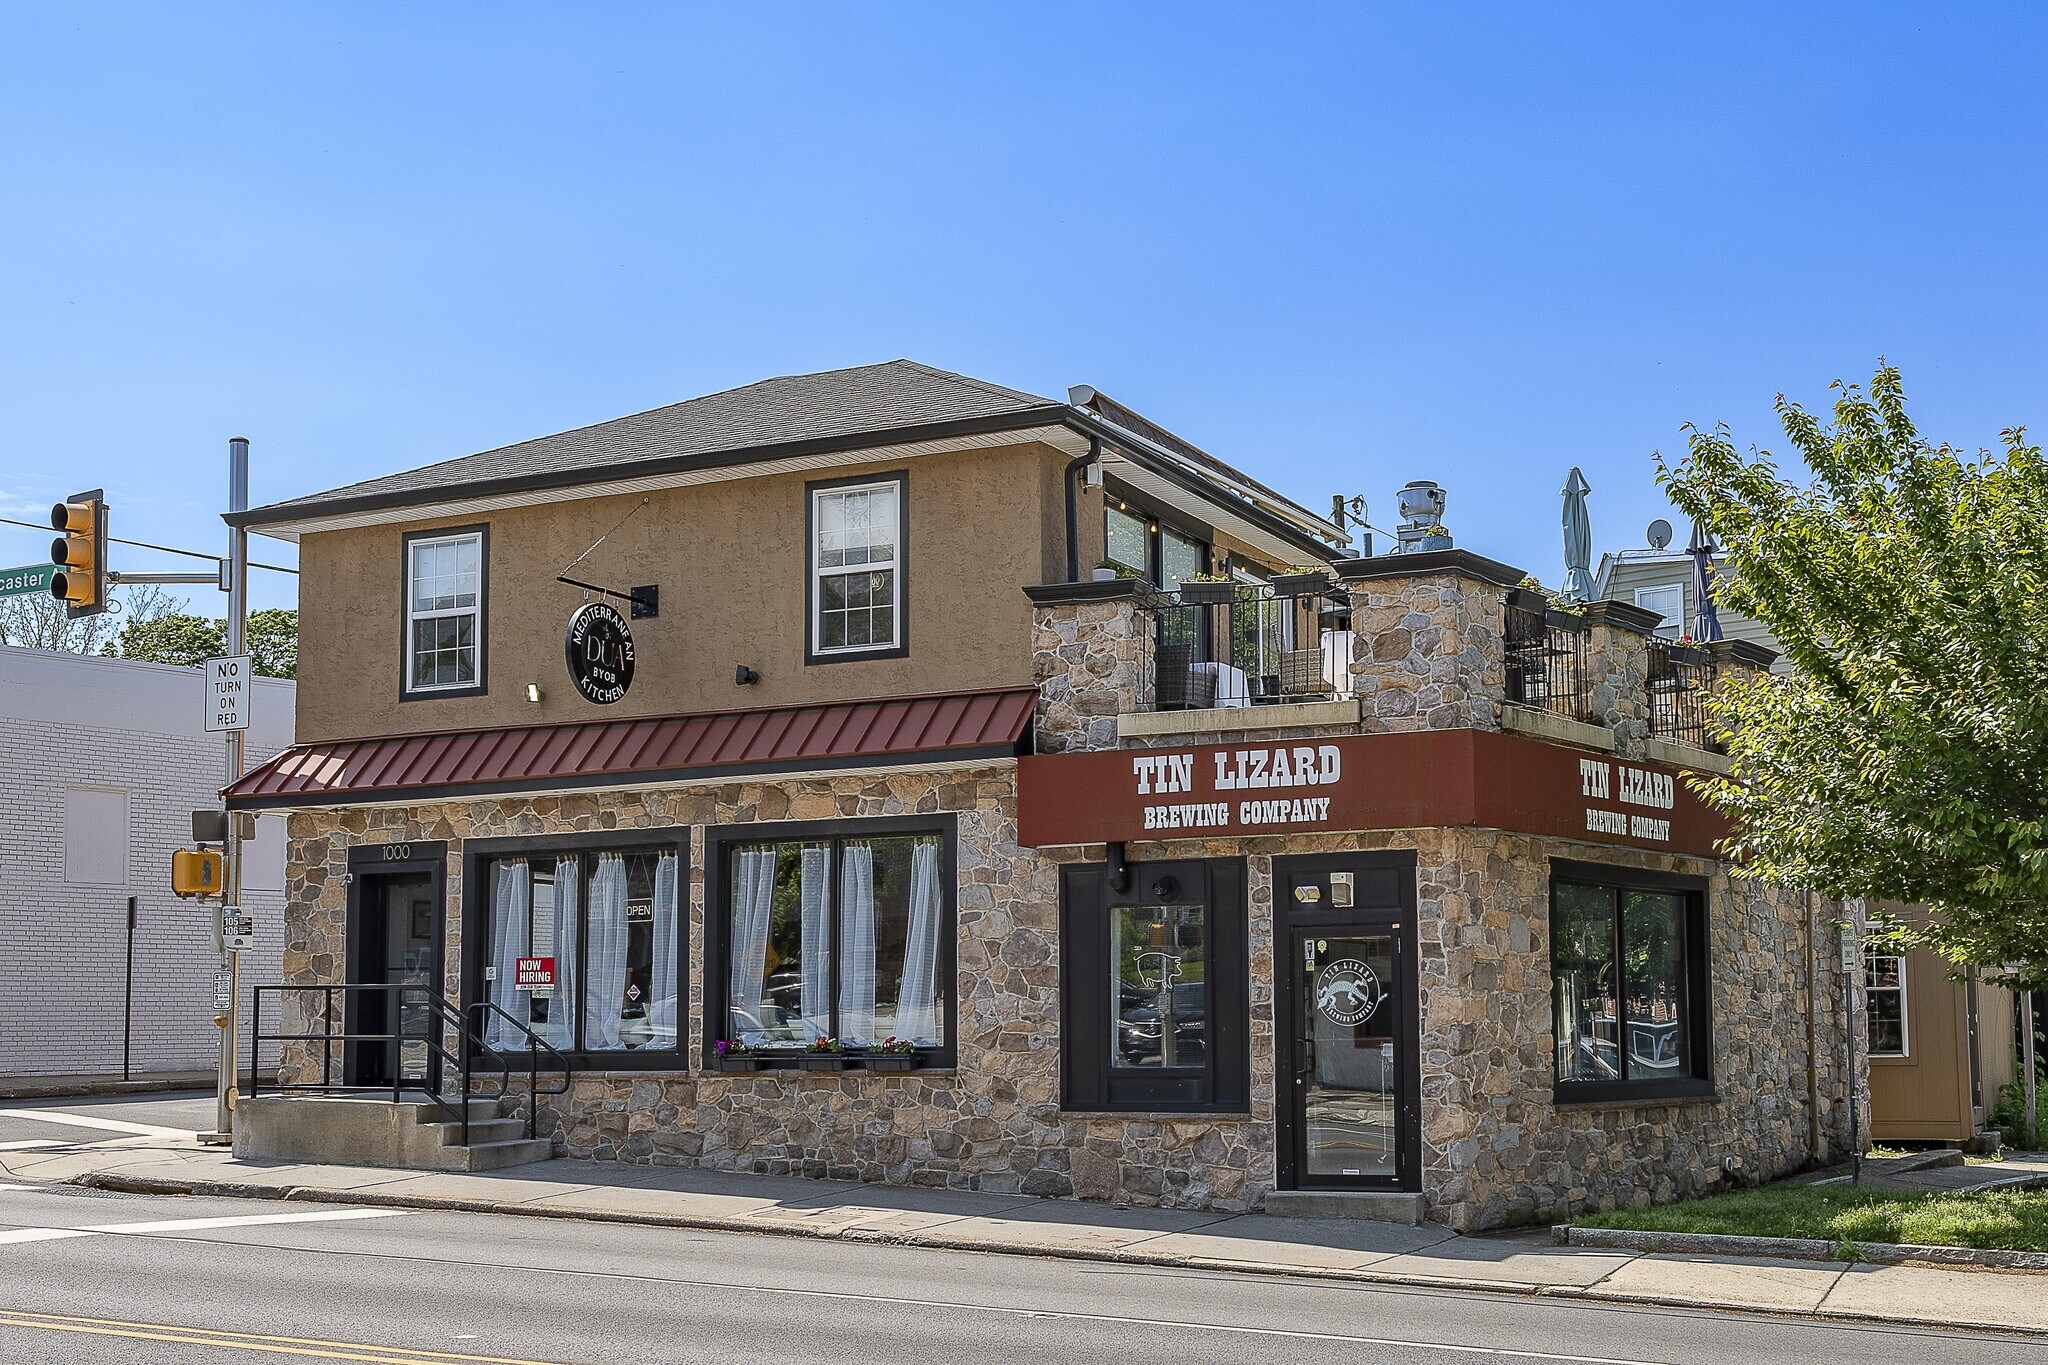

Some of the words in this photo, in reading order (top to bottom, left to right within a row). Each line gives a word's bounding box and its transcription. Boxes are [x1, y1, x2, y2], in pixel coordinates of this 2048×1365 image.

[573, 606, 634, 660] MEDITERRANEAN
[587, 635, 625, 671] DUA
[218, 663, 238, 678] NO
[593, 667, 616, 683] BYOB
[215, 681, 241, 694] TURN
[581, 675, 624, 702] KITCHEN
[220, 697, 235, 709] ON
[217, 713, 237, 725] RED
[1133, 754, 1194, 795] TIN
[1214, 745, 1342, 790] LIZARD
[1580, 758, 1610, 799] TIN
[1618, 766, 1674, 810] LIZARD
[1144, 802, 1230, 830] BREWING
[1240, 797, 1331, 825] COMPANY
[1586, 808, 1627, 835] BREWING
[1631, 815, 1670, 841] COMPANY
[382, 845, 410, 860] 1000
[626, 905, 651, 916] OPEN
[224, 917, 238, 926] 105
[224, 926, 239, 935] 106
[519, 960, 541, 971] NOW
[1324, 965, 1339, 979] TIN
[1343, 962, 1374, 983] LIZARD
[519, 971, 551, 983] HIRING
